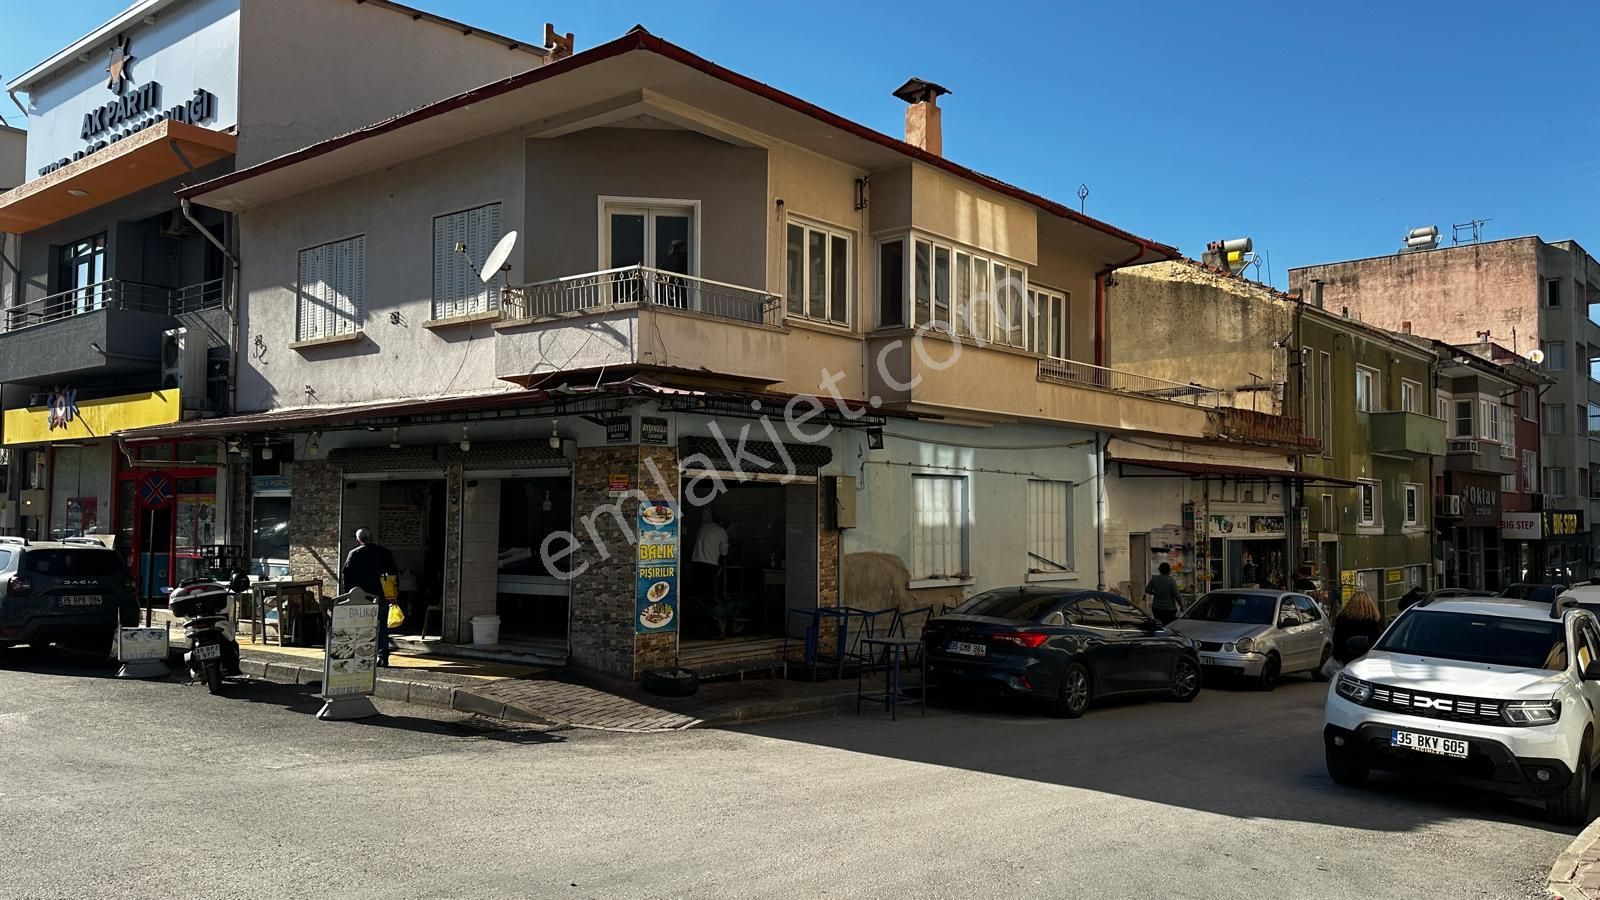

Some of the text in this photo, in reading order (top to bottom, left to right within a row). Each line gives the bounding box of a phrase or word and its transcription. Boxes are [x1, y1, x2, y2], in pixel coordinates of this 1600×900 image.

[80, 81, 157, 139] AK PARTİ
[1501, 520, 1534, 530] BIG STEP
[640, 544, 675, 560] BALIK
[1398, 732, 1465, 754] 35 BKV 605
